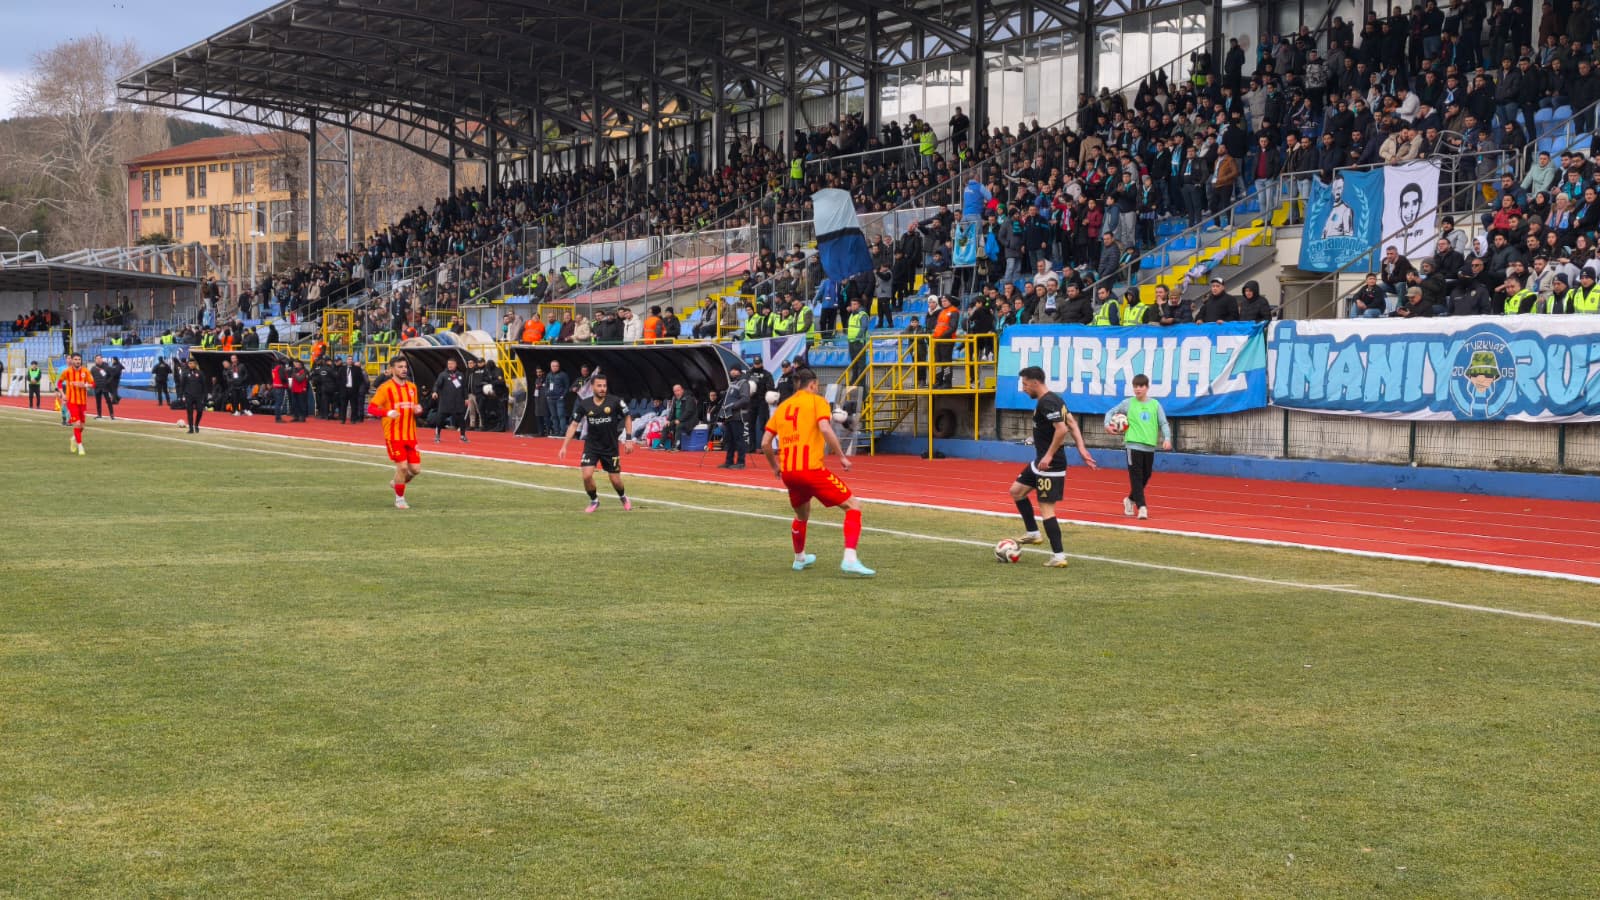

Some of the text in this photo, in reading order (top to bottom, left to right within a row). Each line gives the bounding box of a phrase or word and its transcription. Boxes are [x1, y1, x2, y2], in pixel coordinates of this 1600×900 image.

[1011, 335, 1249, 397] TURKUAZ
[785, 404, 800, 431] 4
[612, 456, 619, 467] 7
[1037, 478, 1052, 490] 30
